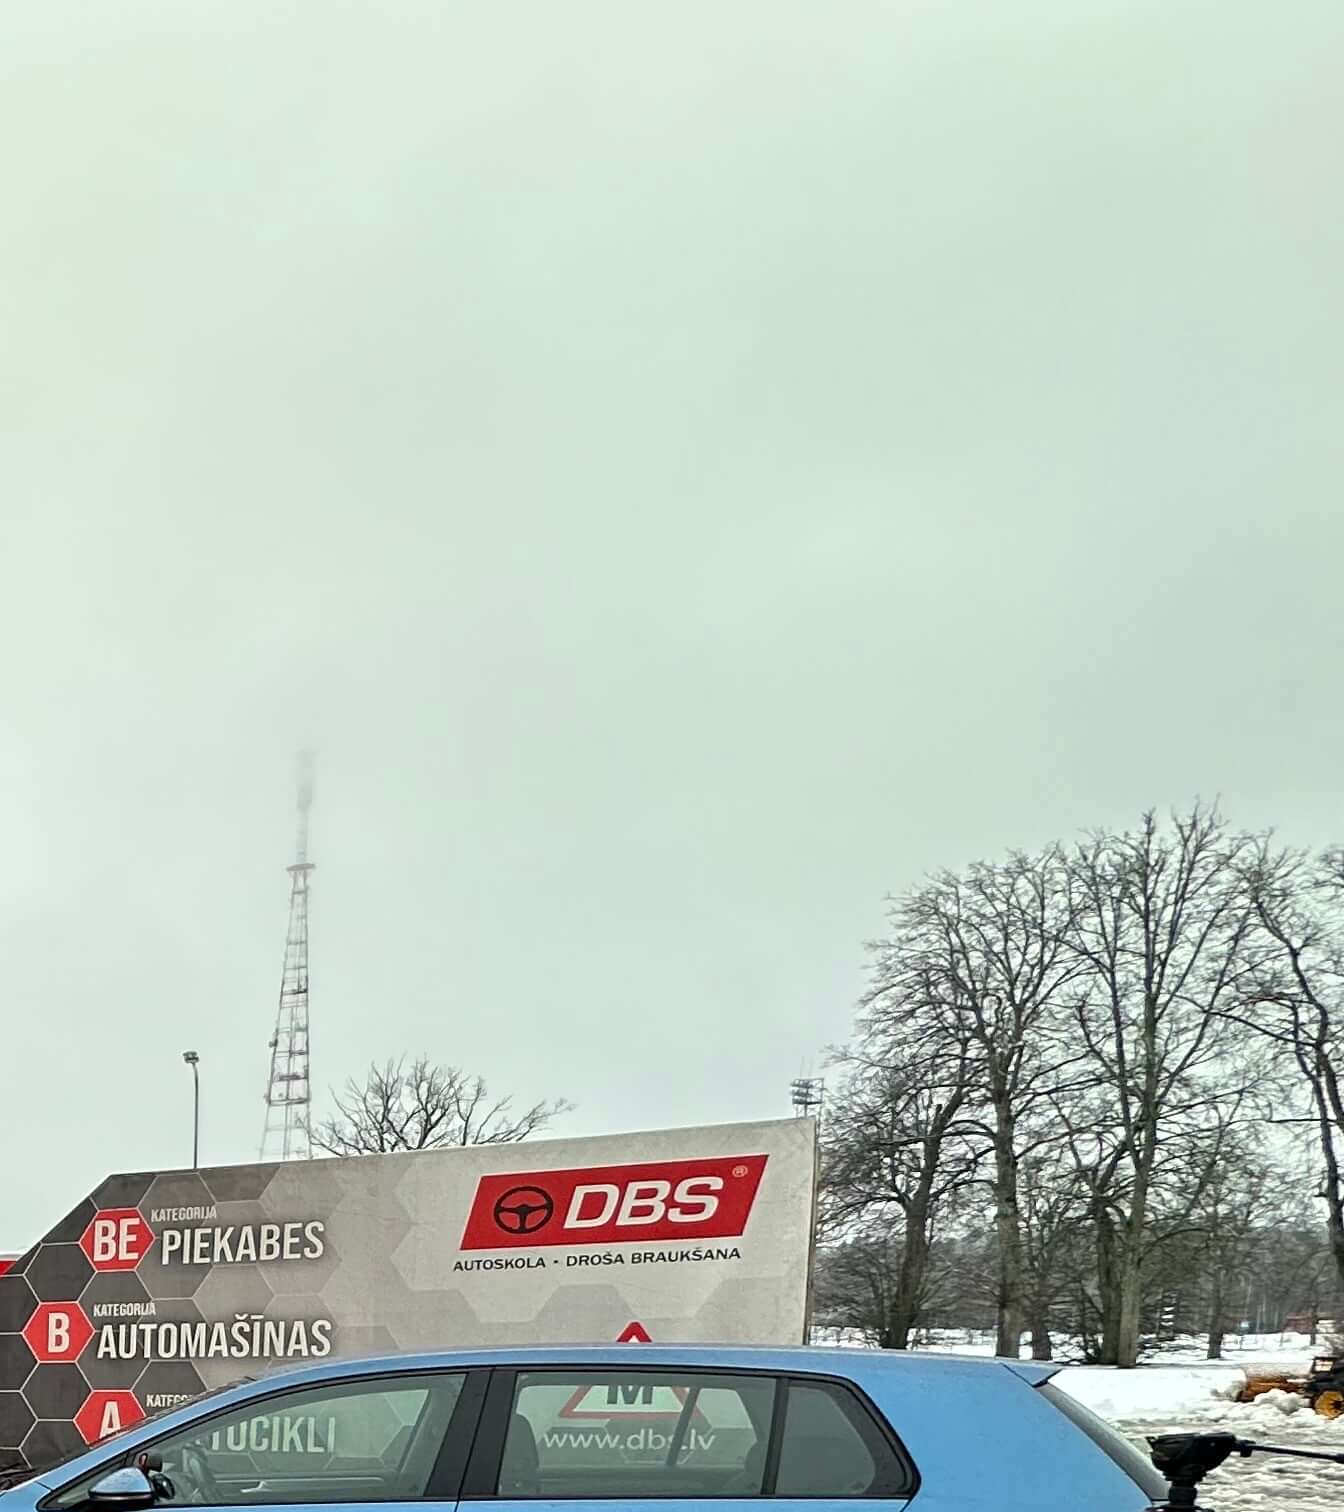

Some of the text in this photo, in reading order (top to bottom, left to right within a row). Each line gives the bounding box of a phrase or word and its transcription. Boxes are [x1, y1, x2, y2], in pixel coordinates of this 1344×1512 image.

[151, 1206, 217, 1222] KATEGORIJA
[563, 1176, 724, 1229] DBS
[93, 1217, 140, 1261] BE
[162, 1221, 325, 1265] PIEKABES
[453, 1247, 741, 1272] AUTOSKOLA DROŠA BRAUKŠANA
[93, 1302, 156, 1317] KATEGORIJA
[47, 1312, 70, 1353] B
[97, 1314, 332, 1359] AUTOMAŠĪNAS
[100, 1401, 121, 1441] A
